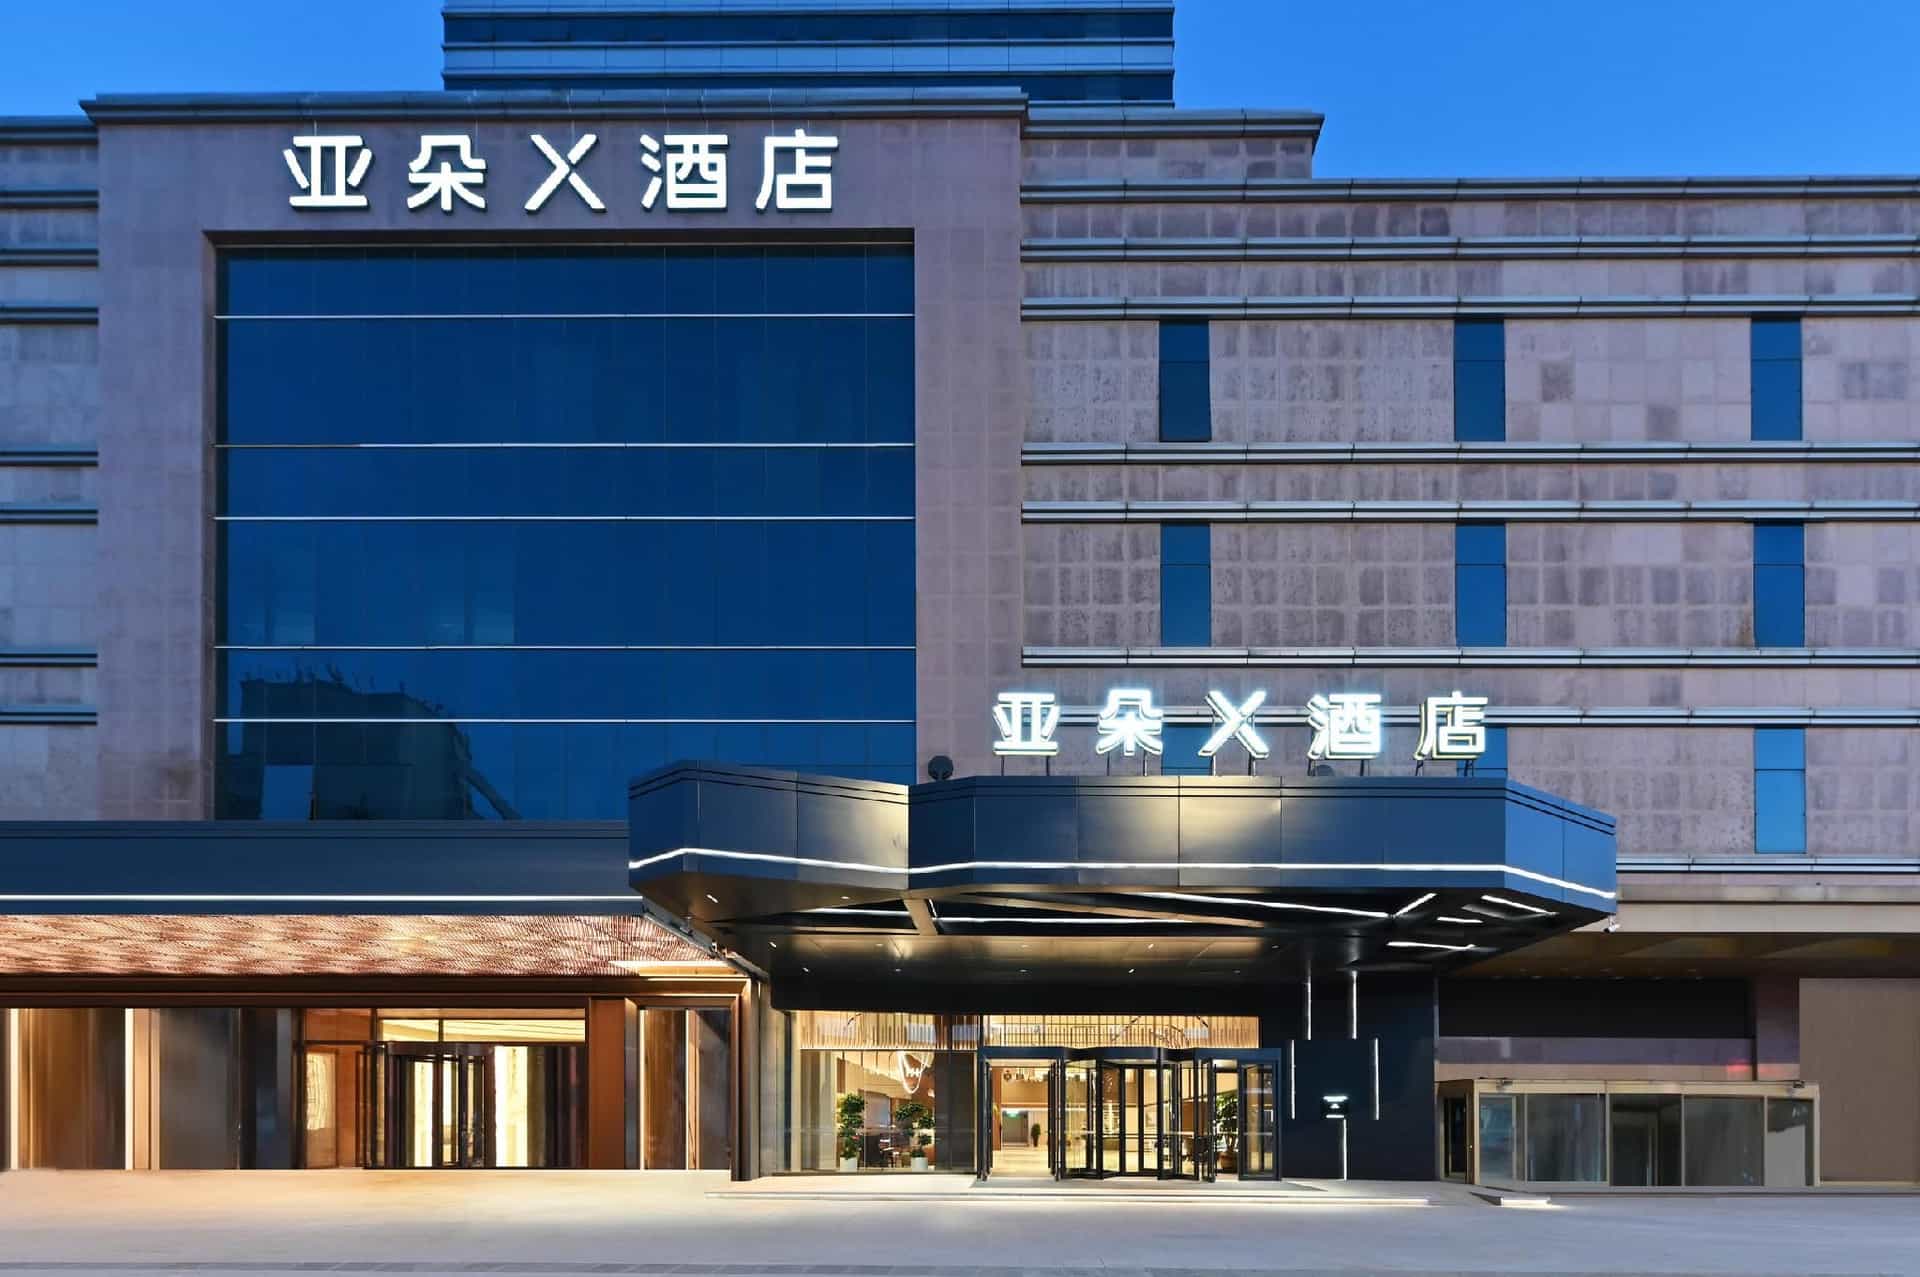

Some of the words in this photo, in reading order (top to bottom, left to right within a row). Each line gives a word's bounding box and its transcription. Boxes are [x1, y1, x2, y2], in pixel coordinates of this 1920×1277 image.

[283, 129, 839, 211] 亚朵X酒店
[992, 688, 1489, 760] 亚朵X酒店
